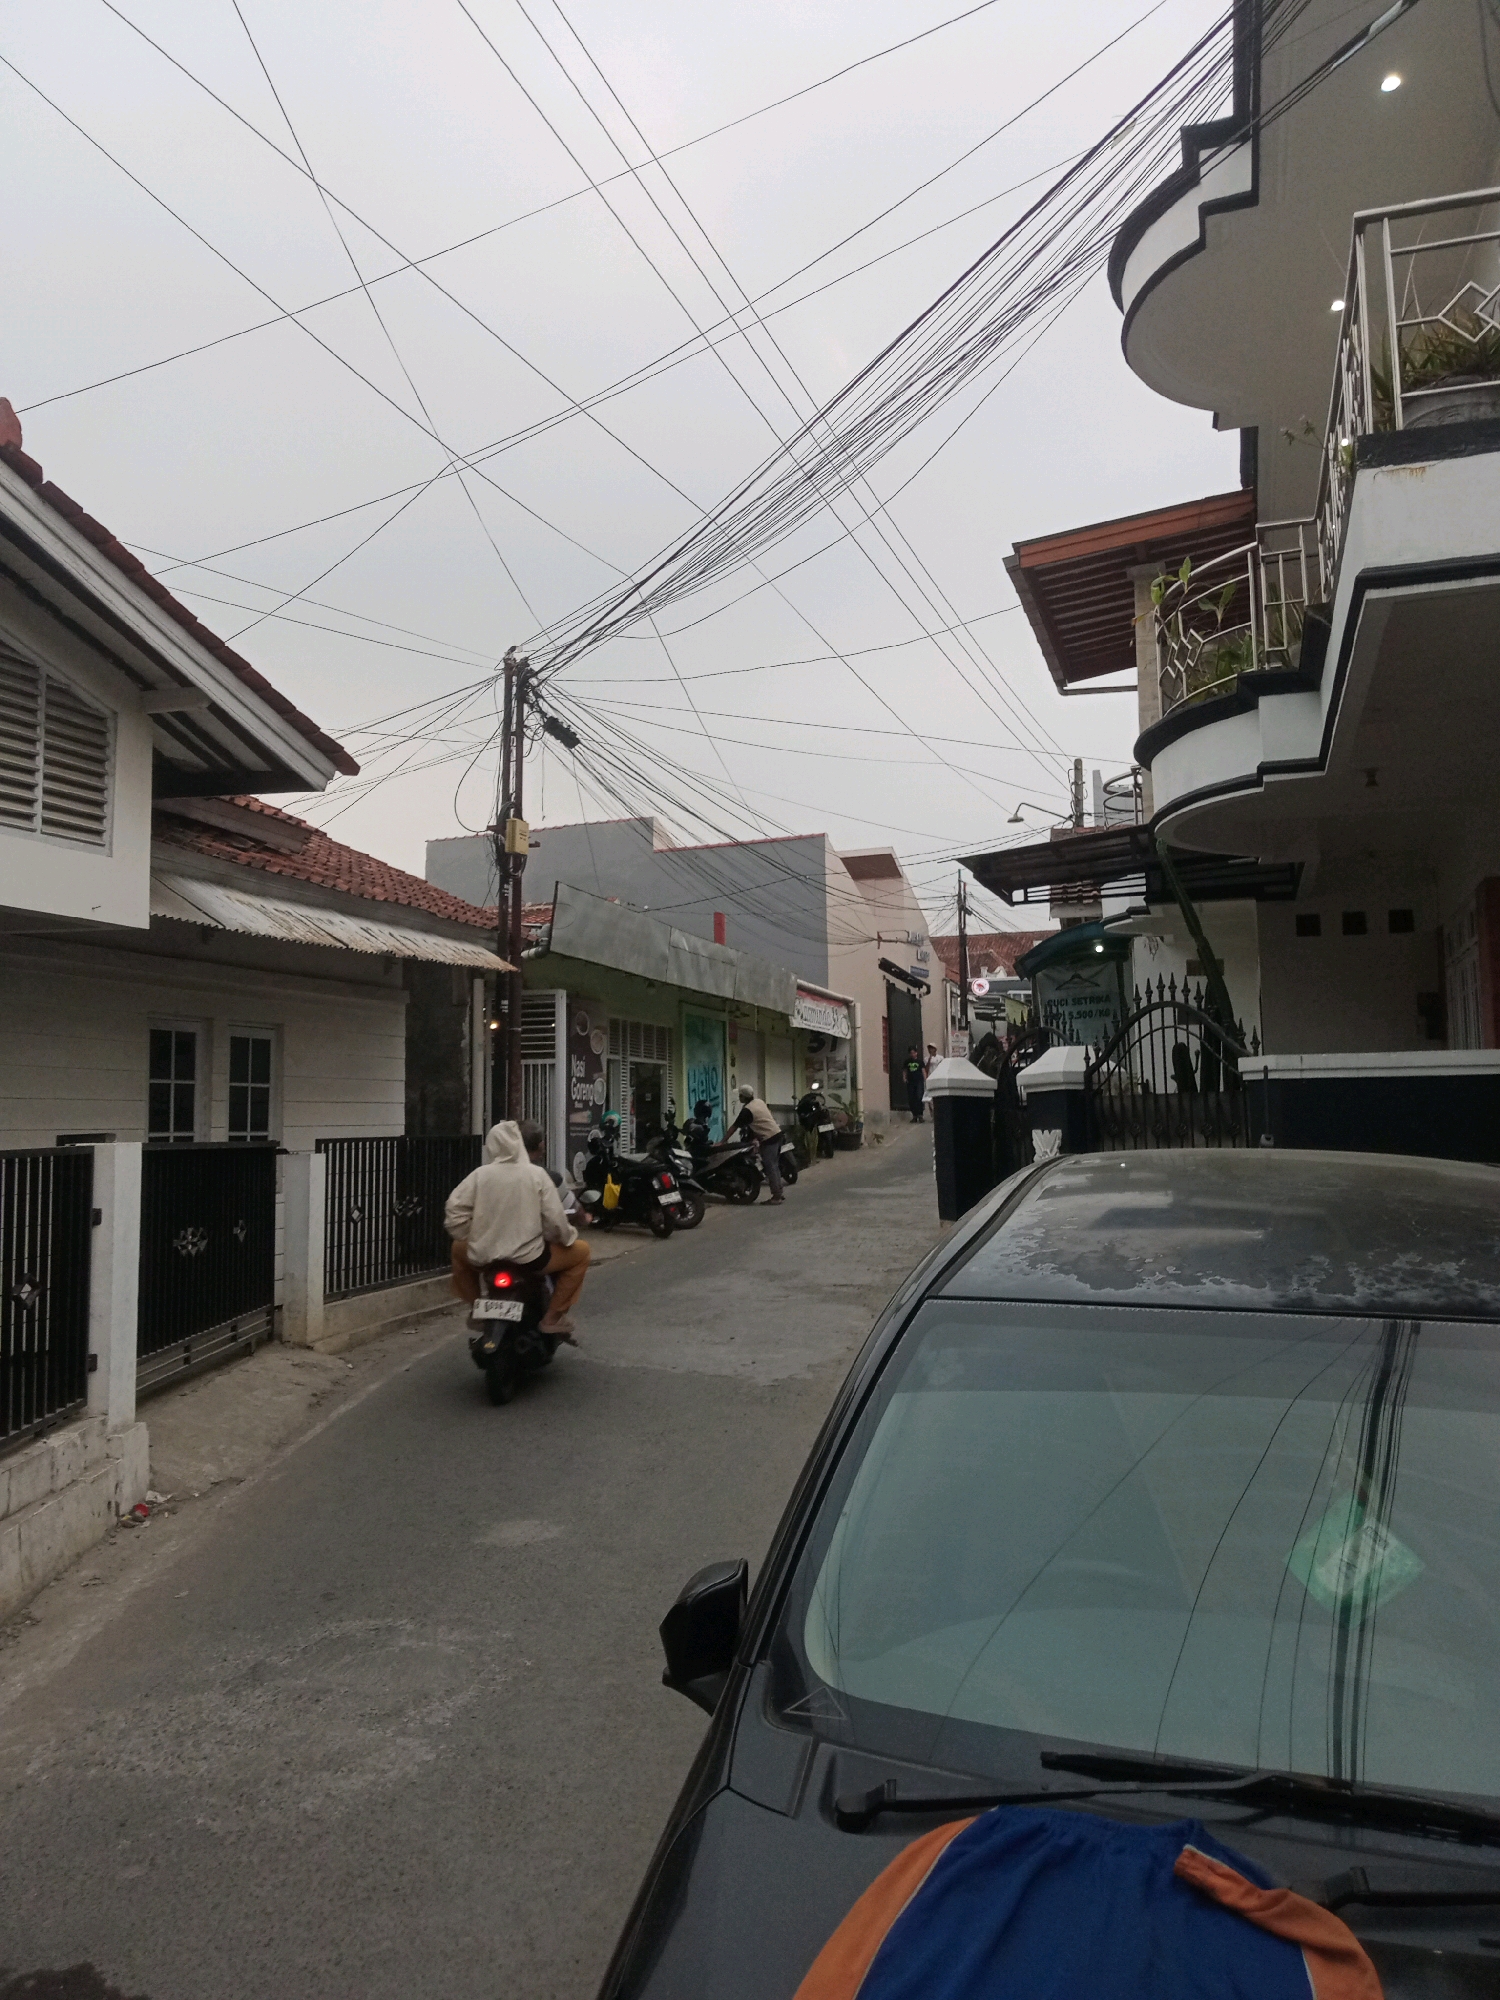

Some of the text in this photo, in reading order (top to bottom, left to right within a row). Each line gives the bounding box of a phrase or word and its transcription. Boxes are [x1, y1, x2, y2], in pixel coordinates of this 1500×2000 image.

[1071, 994, 1111, 1006] SETRIKA
[571, 1054, 586, 1078] Nasi
[571, 1077, 594, 1106] Goreng
